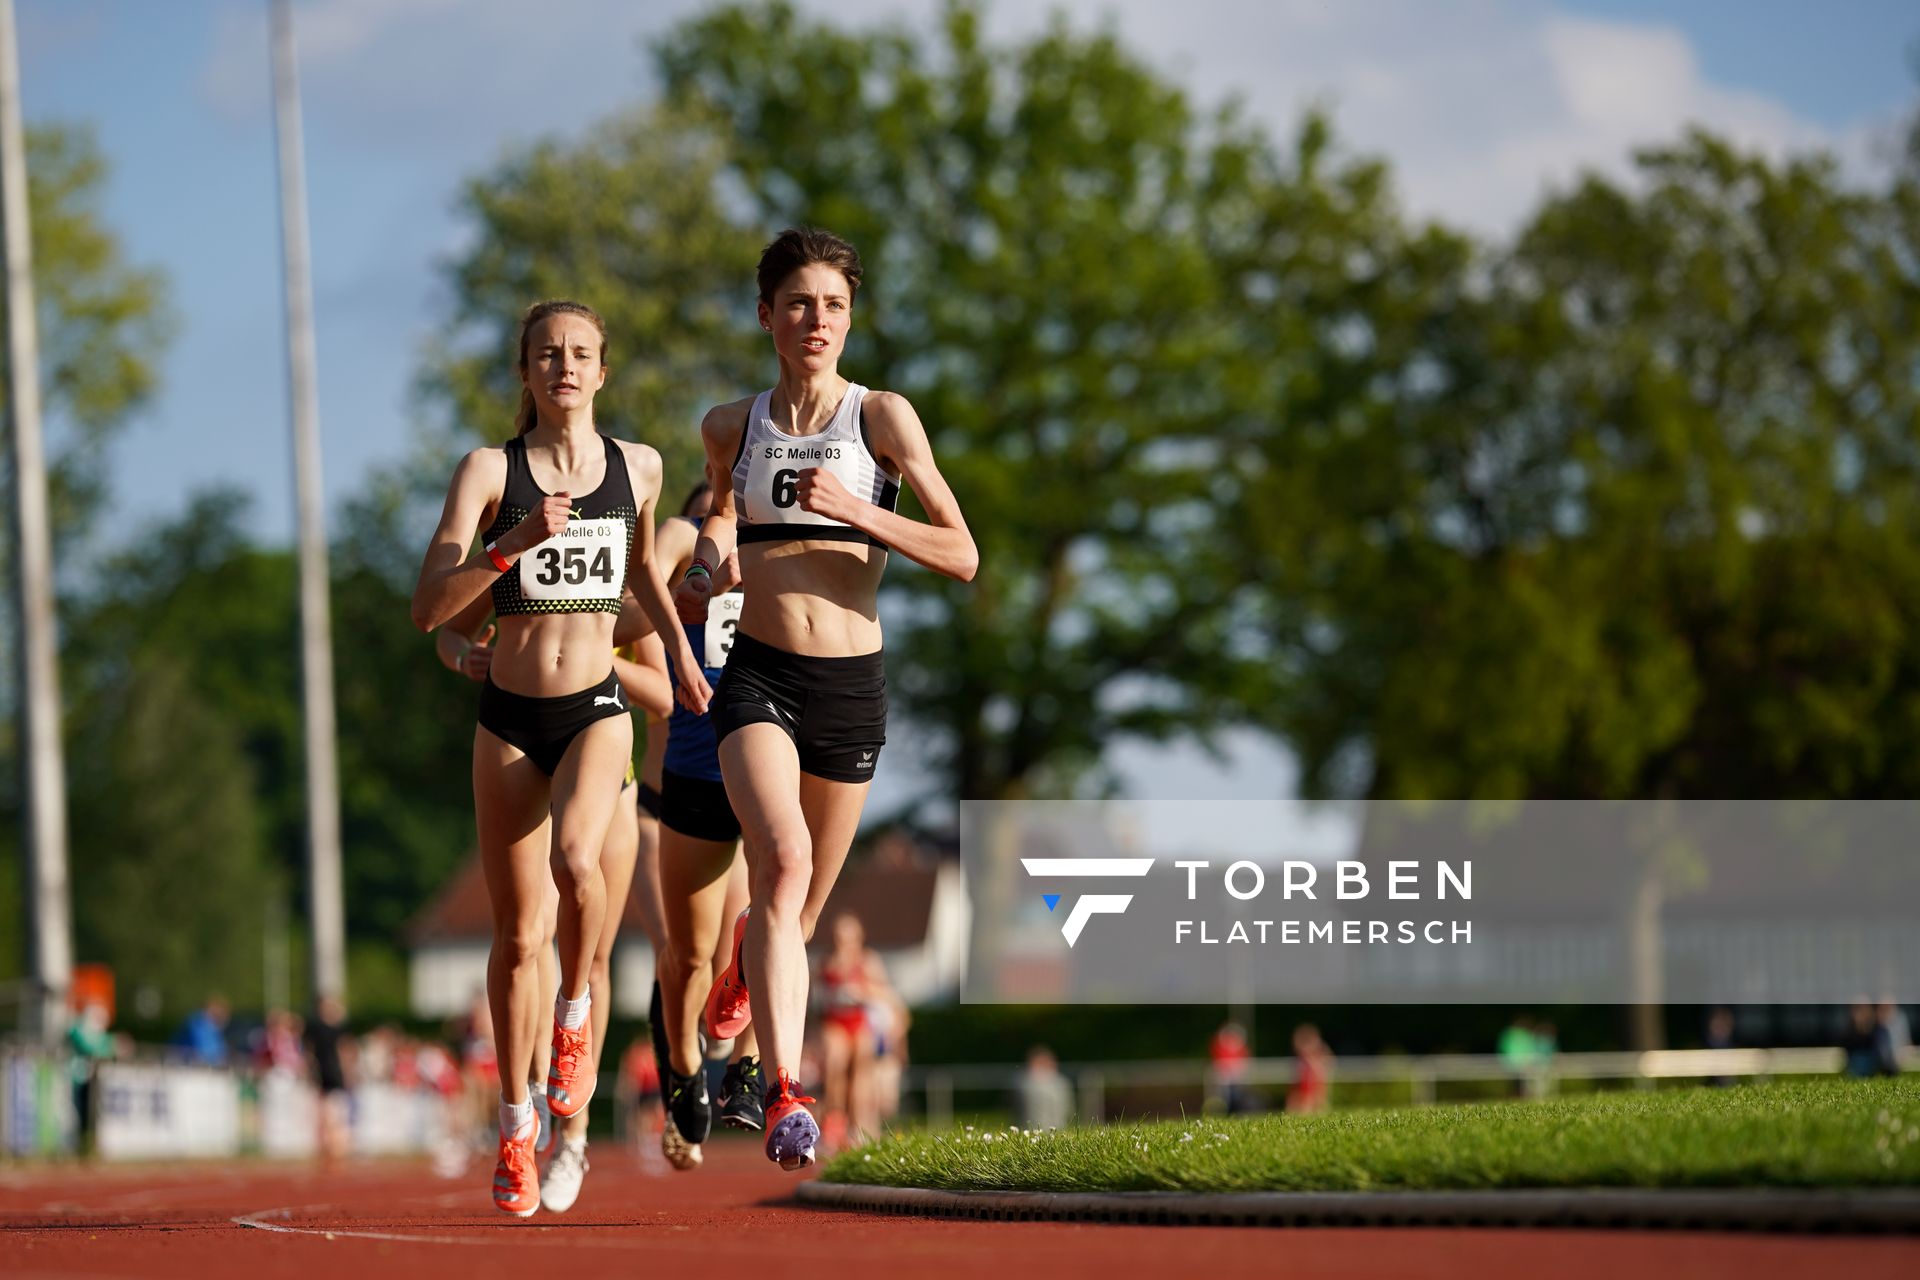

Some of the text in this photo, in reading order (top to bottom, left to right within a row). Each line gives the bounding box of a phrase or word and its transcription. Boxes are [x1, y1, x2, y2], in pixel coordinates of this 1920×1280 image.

[764, 447, 841, 460] SC Melle 03
[771, 468, 799, 509] 6
[560, 526, 594, 538] Melle
[597, 526, 612, 537] 03
[535, 546, 614, 586] 354
[723, 599, 740, 610] SC
[720, 618, 739, 653] 3
